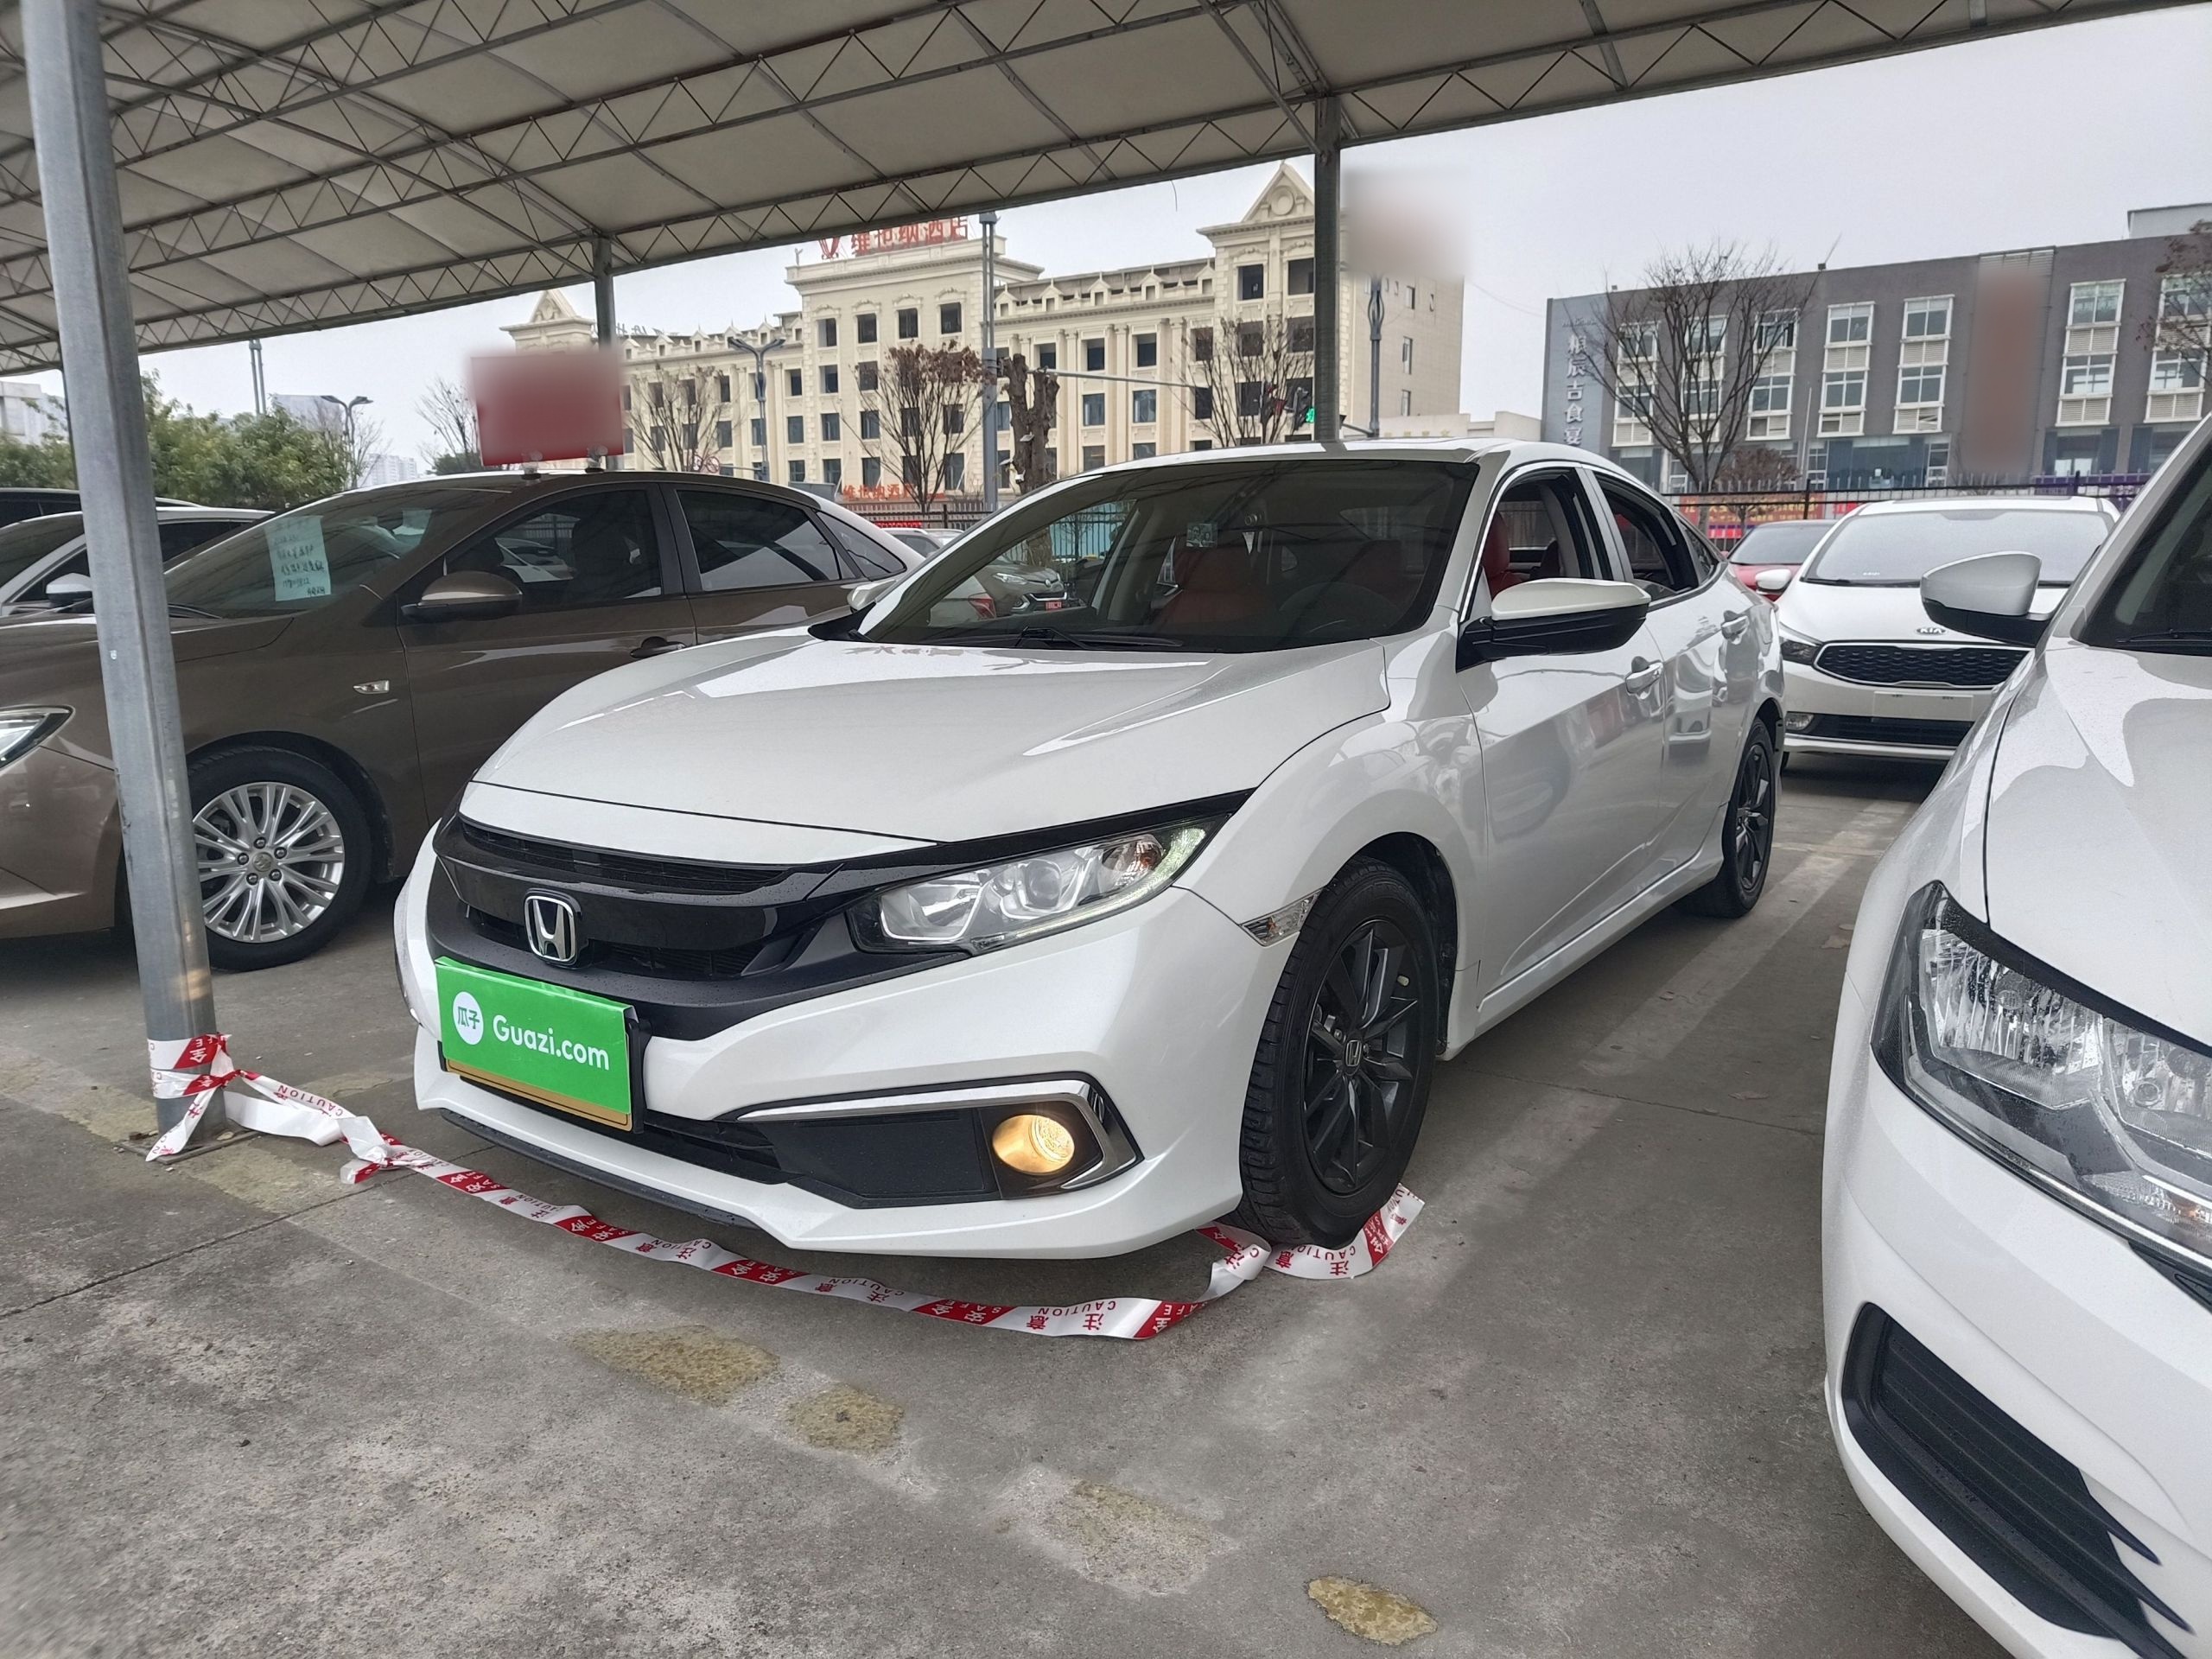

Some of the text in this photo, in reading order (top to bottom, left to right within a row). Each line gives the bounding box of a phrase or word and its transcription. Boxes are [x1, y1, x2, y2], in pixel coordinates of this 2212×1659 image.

[457, 1006, 480, 1030] 瓜子
[493, 1014, 610, 1071] Guazi.com
[277, 1084, 344, 1116] CAUTION
[1291, 1245, 1356, 1260] CAUTIO
[1274, 1251, 1349, 1275] 注意
[829, 1279, 905, 1296] CAUTION
[931, 1304, 987, 1322] 安全
[944, 1300, 1001, 1313] SAFE
[1038, 1300, 1116, 1317] CAUTION
[1026, 1313, 1104, 1331] 注意
